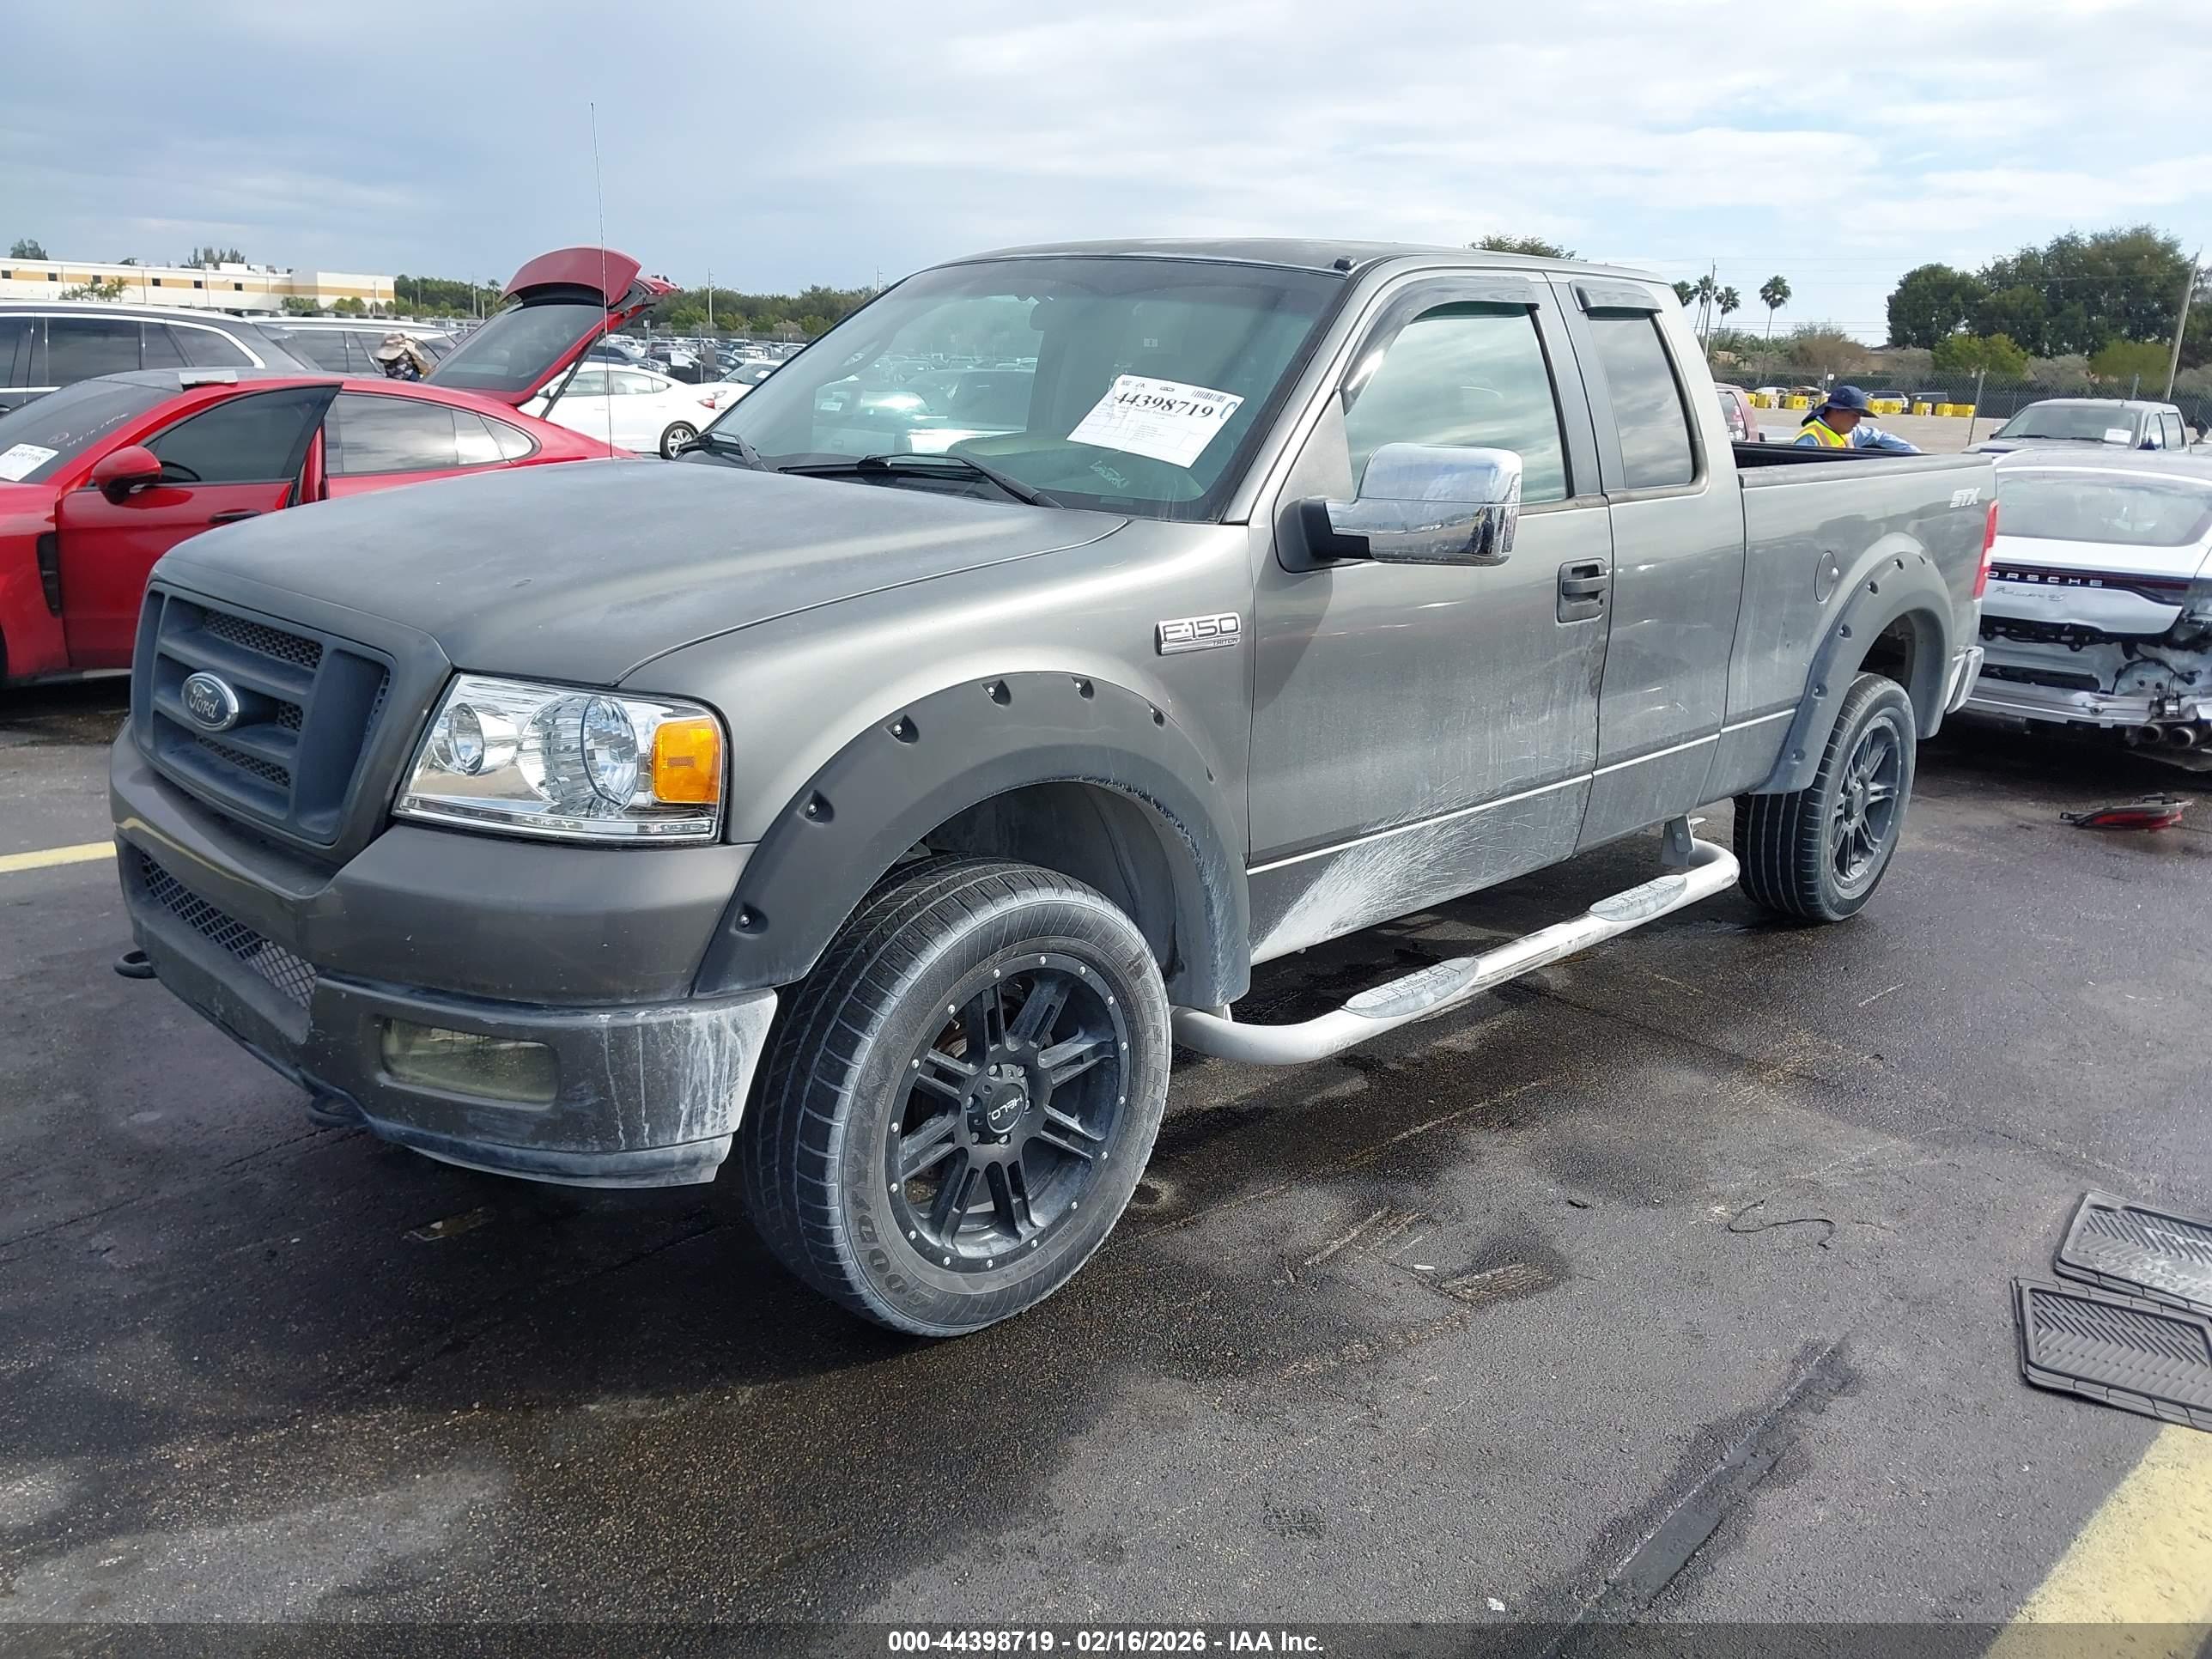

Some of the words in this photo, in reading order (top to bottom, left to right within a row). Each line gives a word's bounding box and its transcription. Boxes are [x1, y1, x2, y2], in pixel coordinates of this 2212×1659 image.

[1114, 392, 1214, 418] 44398719
[1949, 487, 1981, 508] STX
[1986, 570, 2103, 587] ORSCHE
[189, 682, 220, 719] Ford
[991, 1093, 1023, 1121] HELO
